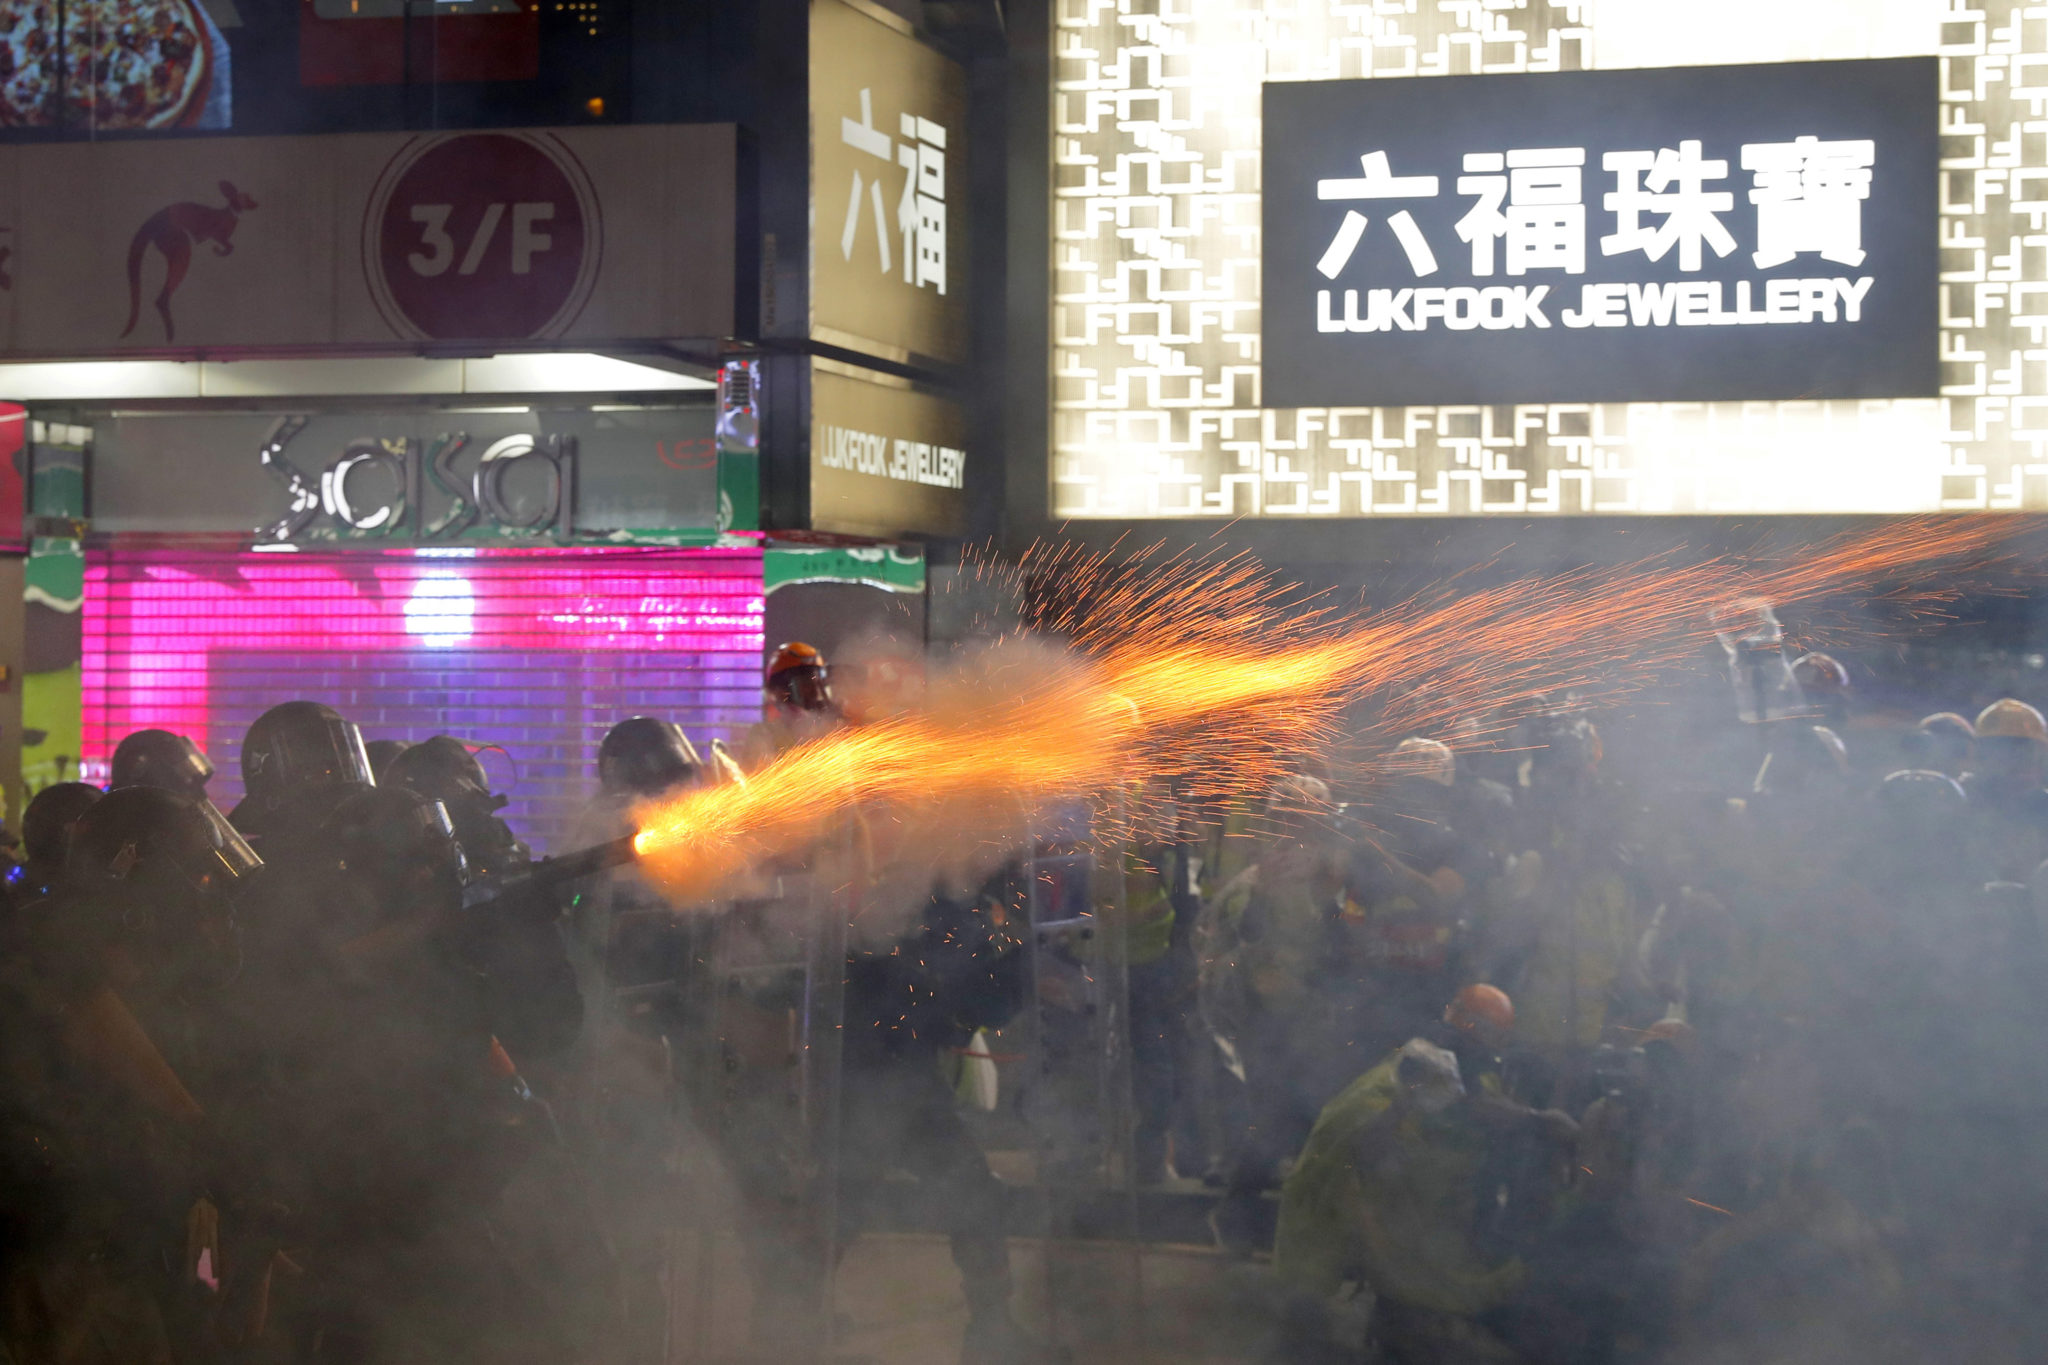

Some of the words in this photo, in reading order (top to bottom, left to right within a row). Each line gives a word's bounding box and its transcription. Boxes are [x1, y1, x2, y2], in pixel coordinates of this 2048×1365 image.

[841, 87, 947, 295] 六福
[1316, 136, 1875, 279] 六福珠寶
[408, 203, 554, 277] 3/F
[1316, 285, 1552, 333] LUKFOOK
[1561, 276, 1875, 328] JEWELLERY
[821, 424, 887, 477] LUKFOOK
[889, 439, 966, 489] JEWELLERY
